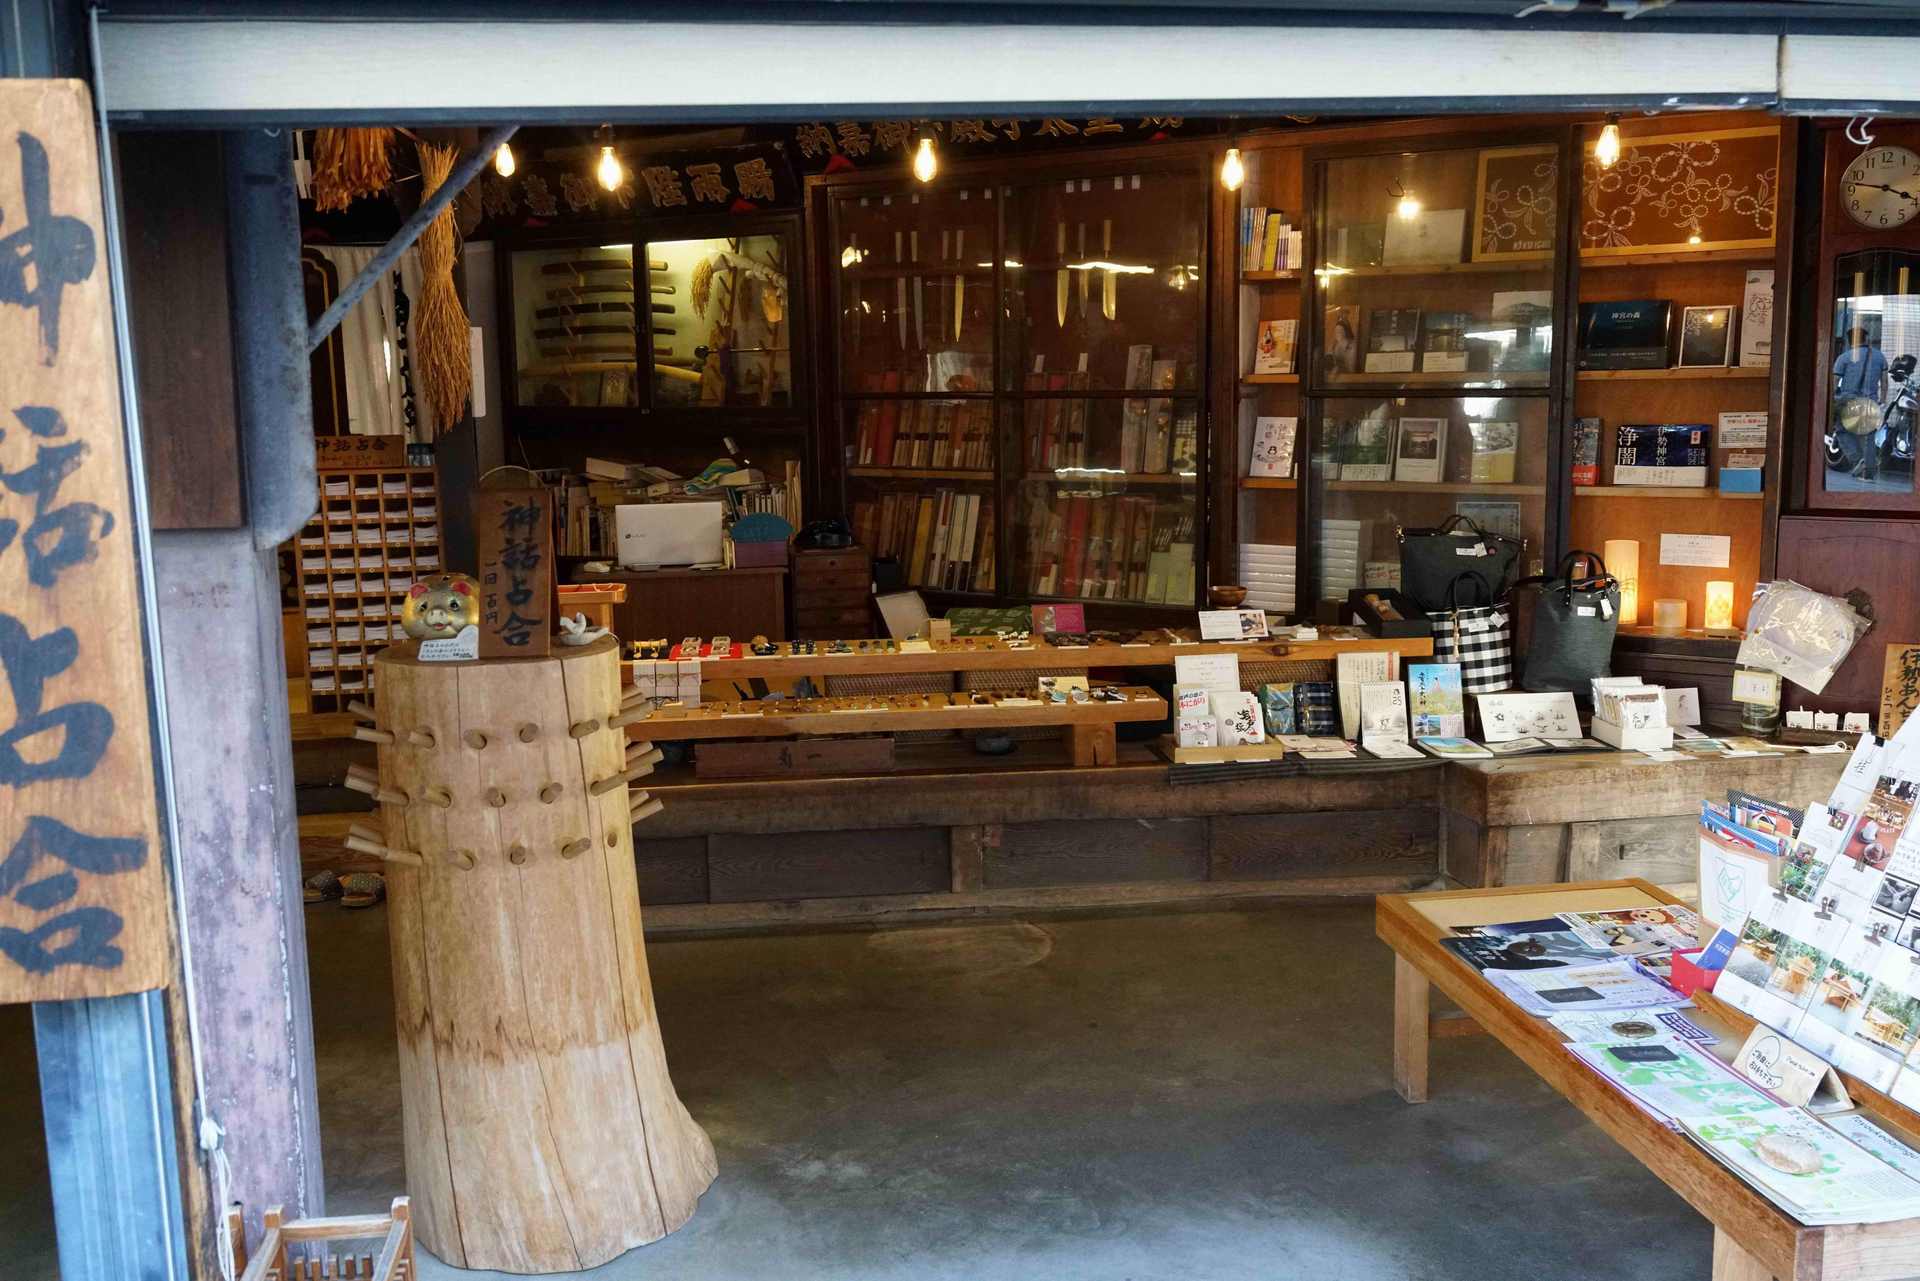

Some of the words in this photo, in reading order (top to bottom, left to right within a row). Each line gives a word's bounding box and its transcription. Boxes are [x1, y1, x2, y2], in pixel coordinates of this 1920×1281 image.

[1866, 157, 1876, 168] 11
[1882, 151, 1895, 163] 12
[1901, 155, 1907, 166] 1
[1852, 170, 1865, 181] 10
[1848, 185, 1856, 196] 9
[1851, 200, 1860, 210] 8
[1864, 210, 1873, 221] 7
[1880, 214, 1889, 225] 6
[1897, 209, 1905, 221] 5
[498, 495, 542, 646] 神話占合
